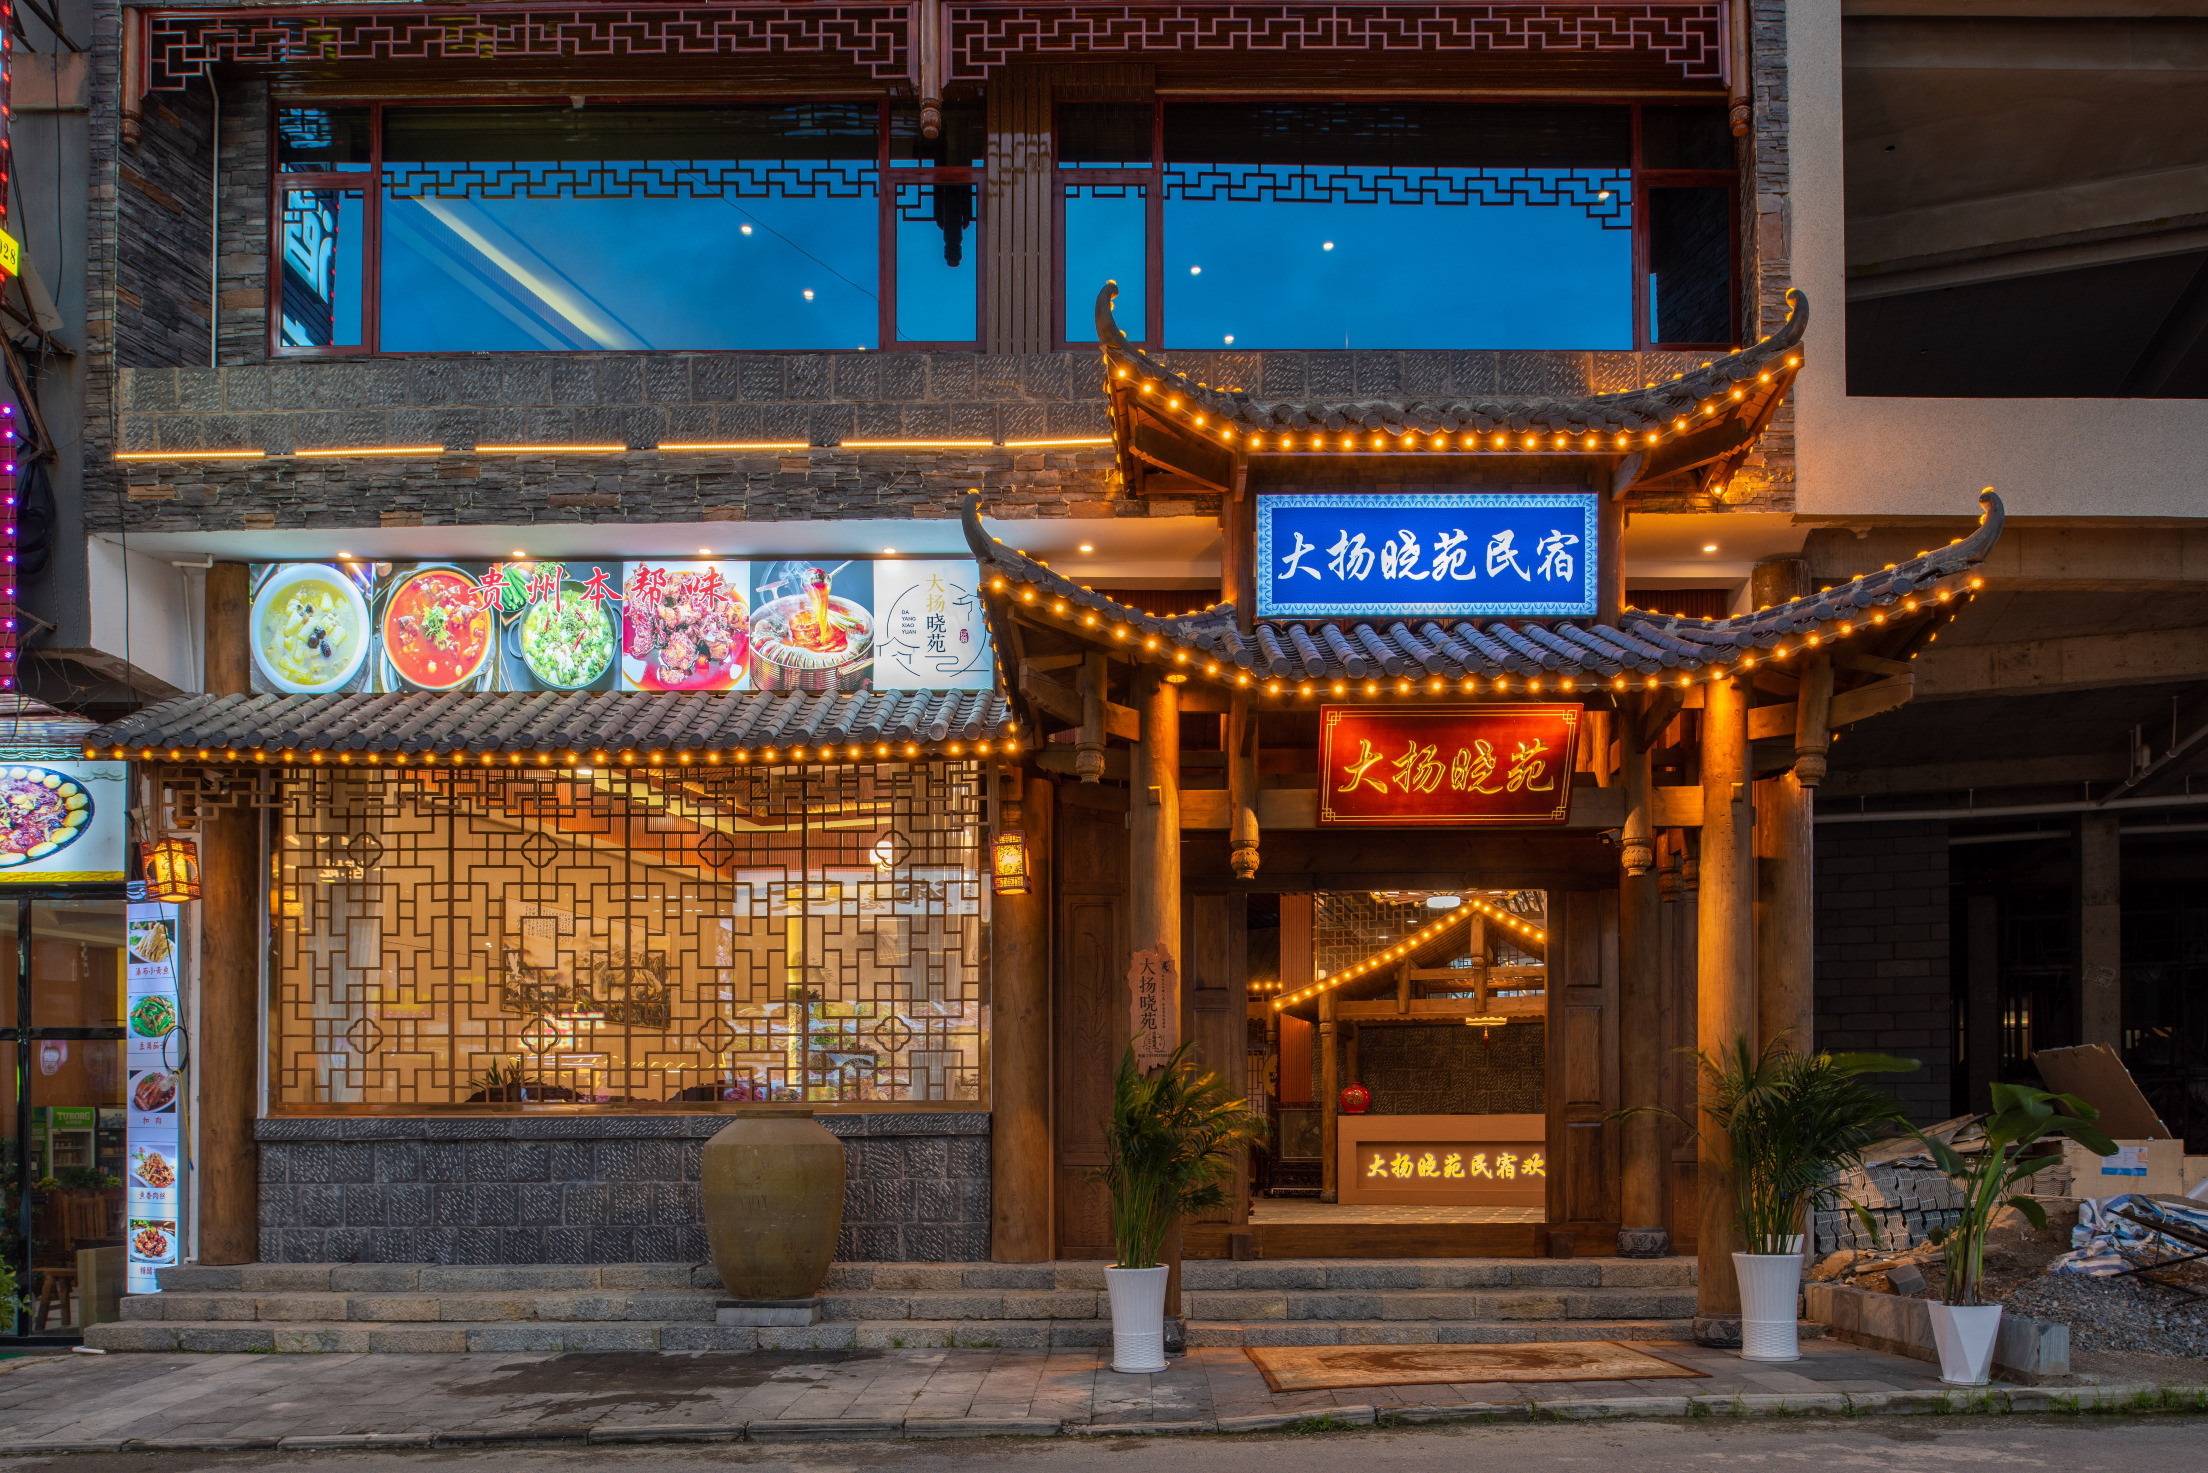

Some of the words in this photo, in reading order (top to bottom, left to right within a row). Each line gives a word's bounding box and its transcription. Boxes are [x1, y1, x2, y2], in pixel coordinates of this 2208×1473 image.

[1278, 529, 1580, 582] 大扬晓苑民宿
[468, 566, 729, 613] 贵州本帮味
[926, 573, 947, 653] 大扬晓苑
[1338, 738, 1554, 794] 大扬晓苑
[1139, 957, 1158, 1030] 大扬晓苑
[56, 1111, 91, 1121] TUBORG
[1367, 1152, 1546, 1180] 大扬晓苑民宿欢
[139, 1190, 166, 1200] 鱼香肉丝
